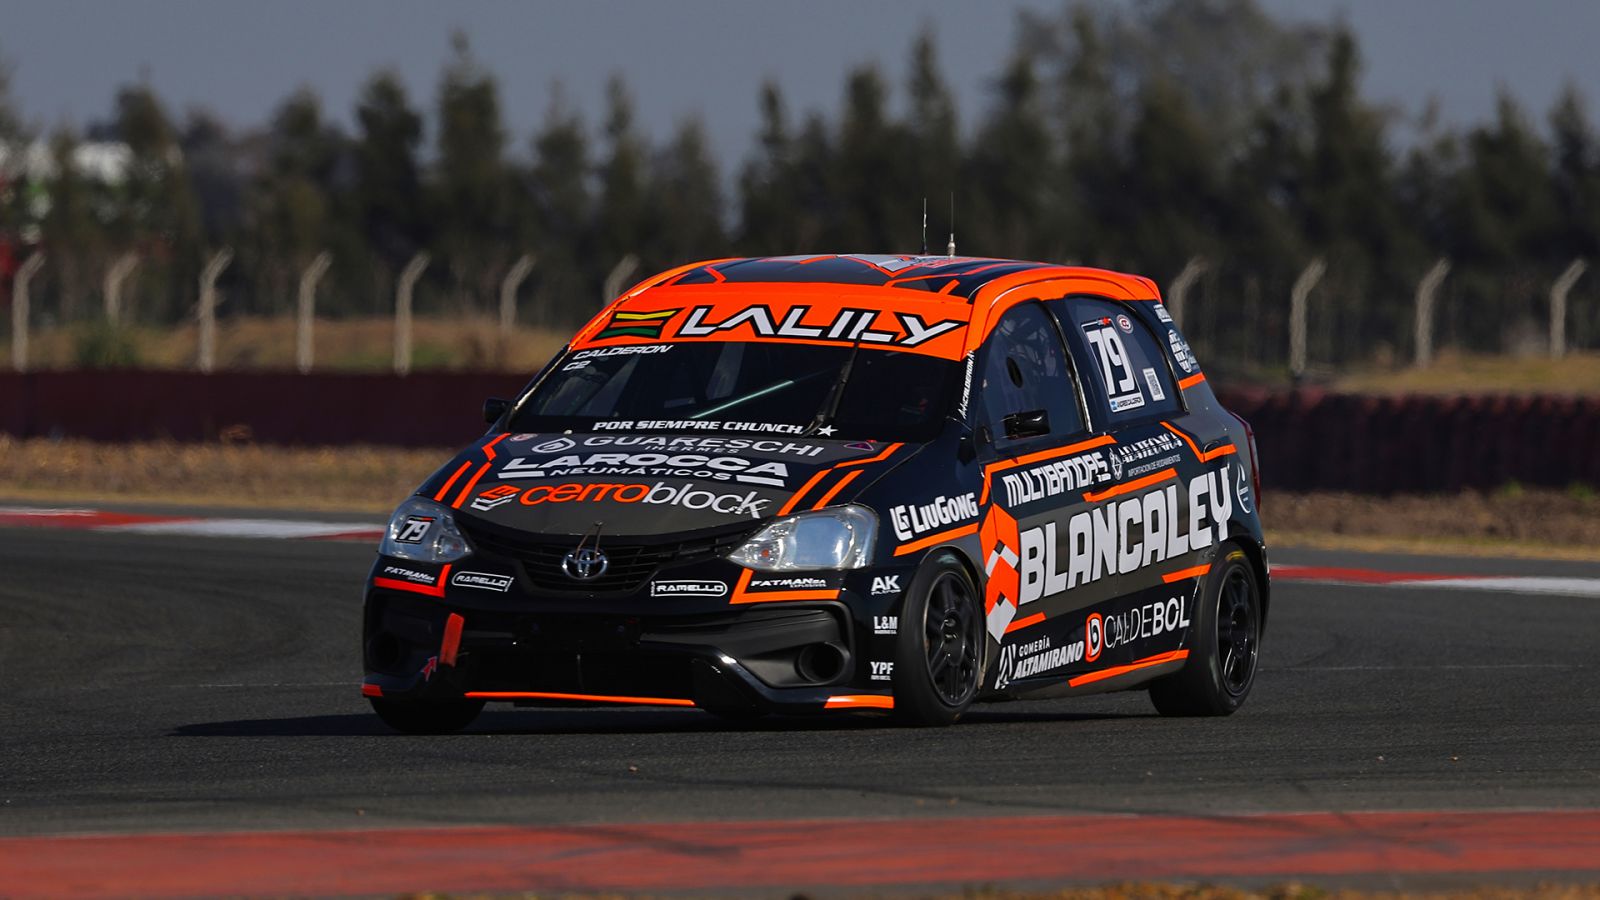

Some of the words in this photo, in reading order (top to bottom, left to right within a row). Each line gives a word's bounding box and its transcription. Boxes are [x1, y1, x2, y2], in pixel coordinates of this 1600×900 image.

[680, 307, 959, 345] LALILY
[573, 345, 674, 360] CALDERON
[1086, 327, 1135, 395] 79
[562, 360, 591, 371] C2
[592, 421, 633, 431] POR
[635, 420, 721, 430] SIEMPRE
[722, 421, 814, 435] CHUNCH
[583, 436, 824, 456] GUARESCHI
[501, 453, 789, 477] LAROCCA
[550, 466, 731, 481] NEUMÁTICOS
[520, 482, 771, 518] cerroblock
[400, 520, 431, 540] 79
[1020, 465, 1232, 606] BLANCALEY
[456, 575, 508, 587] RAMELLO
[656, 584, 724, 592] RAMELLO
[871, 575, 900, 591] AK
[874, 616, 898, 630] L&M
[1104, 596, 1190, 648] CALDEBOL
[1019, 636, 1050, 656] GOMERÍA
[870, 662, 894, 674] YPF
[1013, 641, 1084, 680] ALTAMIRANO
